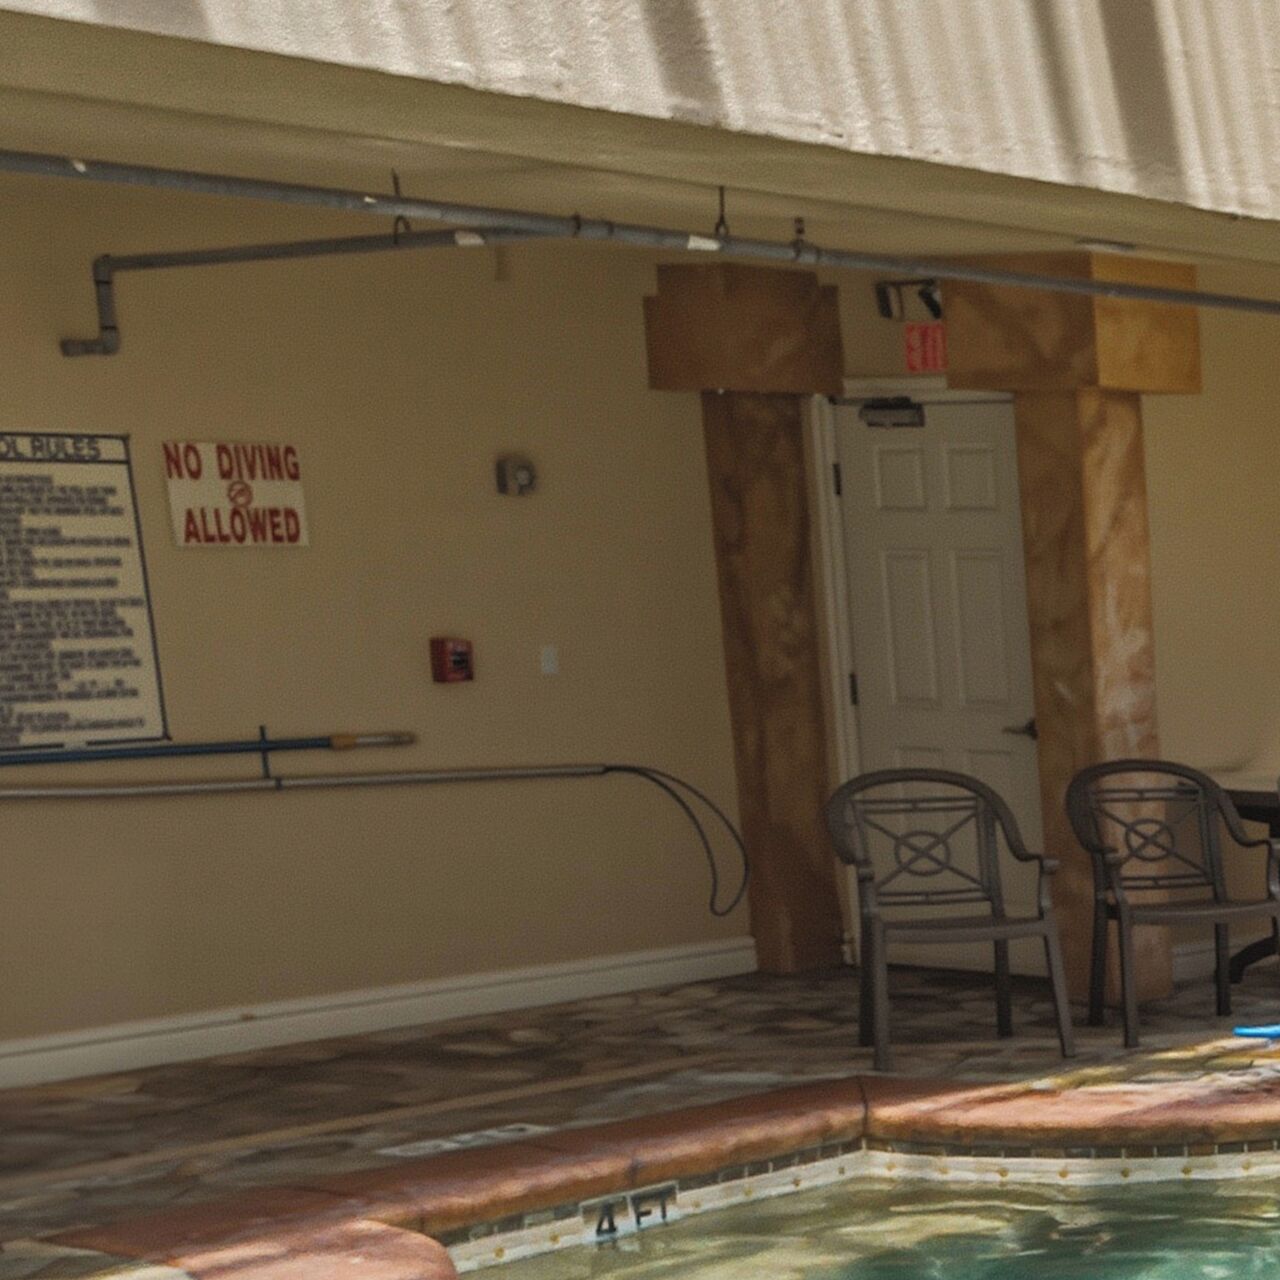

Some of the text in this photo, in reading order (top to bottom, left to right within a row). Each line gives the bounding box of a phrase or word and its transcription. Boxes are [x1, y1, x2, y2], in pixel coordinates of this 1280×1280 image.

[32, 436, 100, 461] RULES
[162, 442, 300, 481] NO DIVING
[184, 507, 300, 543] ALLOWED
[630, 1184, 677, 1227] FT
